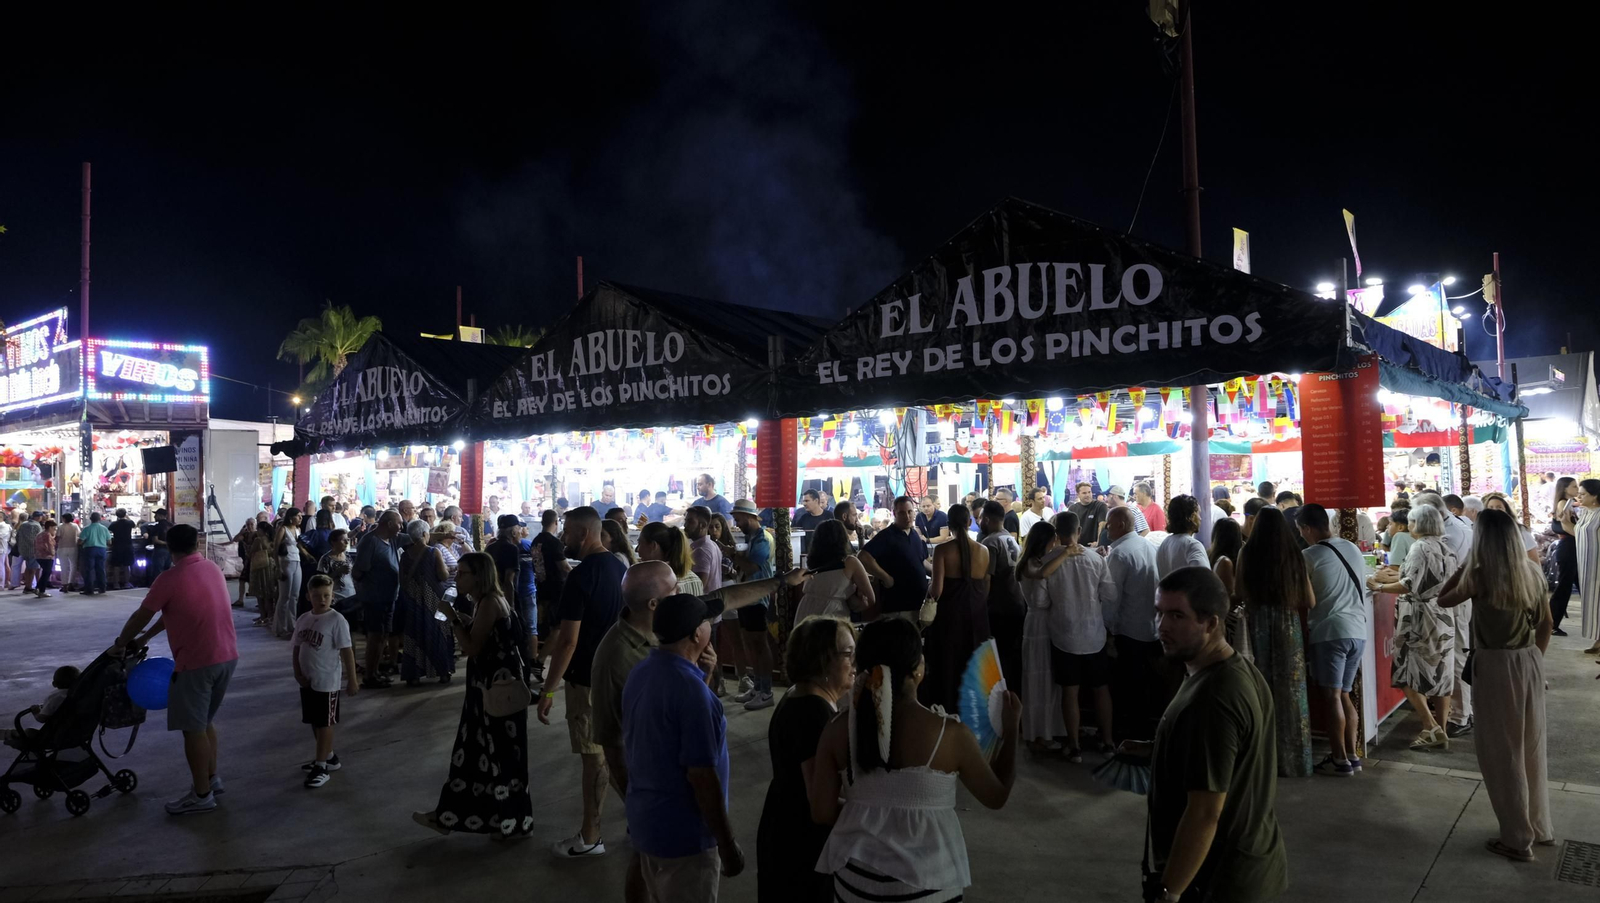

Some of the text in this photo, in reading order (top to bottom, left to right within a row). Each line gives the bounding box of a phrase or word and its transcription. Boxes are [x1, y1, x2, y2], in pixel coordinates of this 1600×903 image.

[880, 261, 1164, 337] EL ABUELO
[531, 329, 685, 382] EL ABUELO
[818, 311, 1263, 384] EL REY DE LOS PINCHITOS
[100, 350, 199, 391] VINOS
[333, 366, 423, 408] EL ABUELO
[1319, 371, 1358, 381] PINCHITOS
[493, 372, 732, 418] EL REY DE LOS PINCHITOS
[307, 406, 447, 434] EL REY DE LOS PINCHITOS
